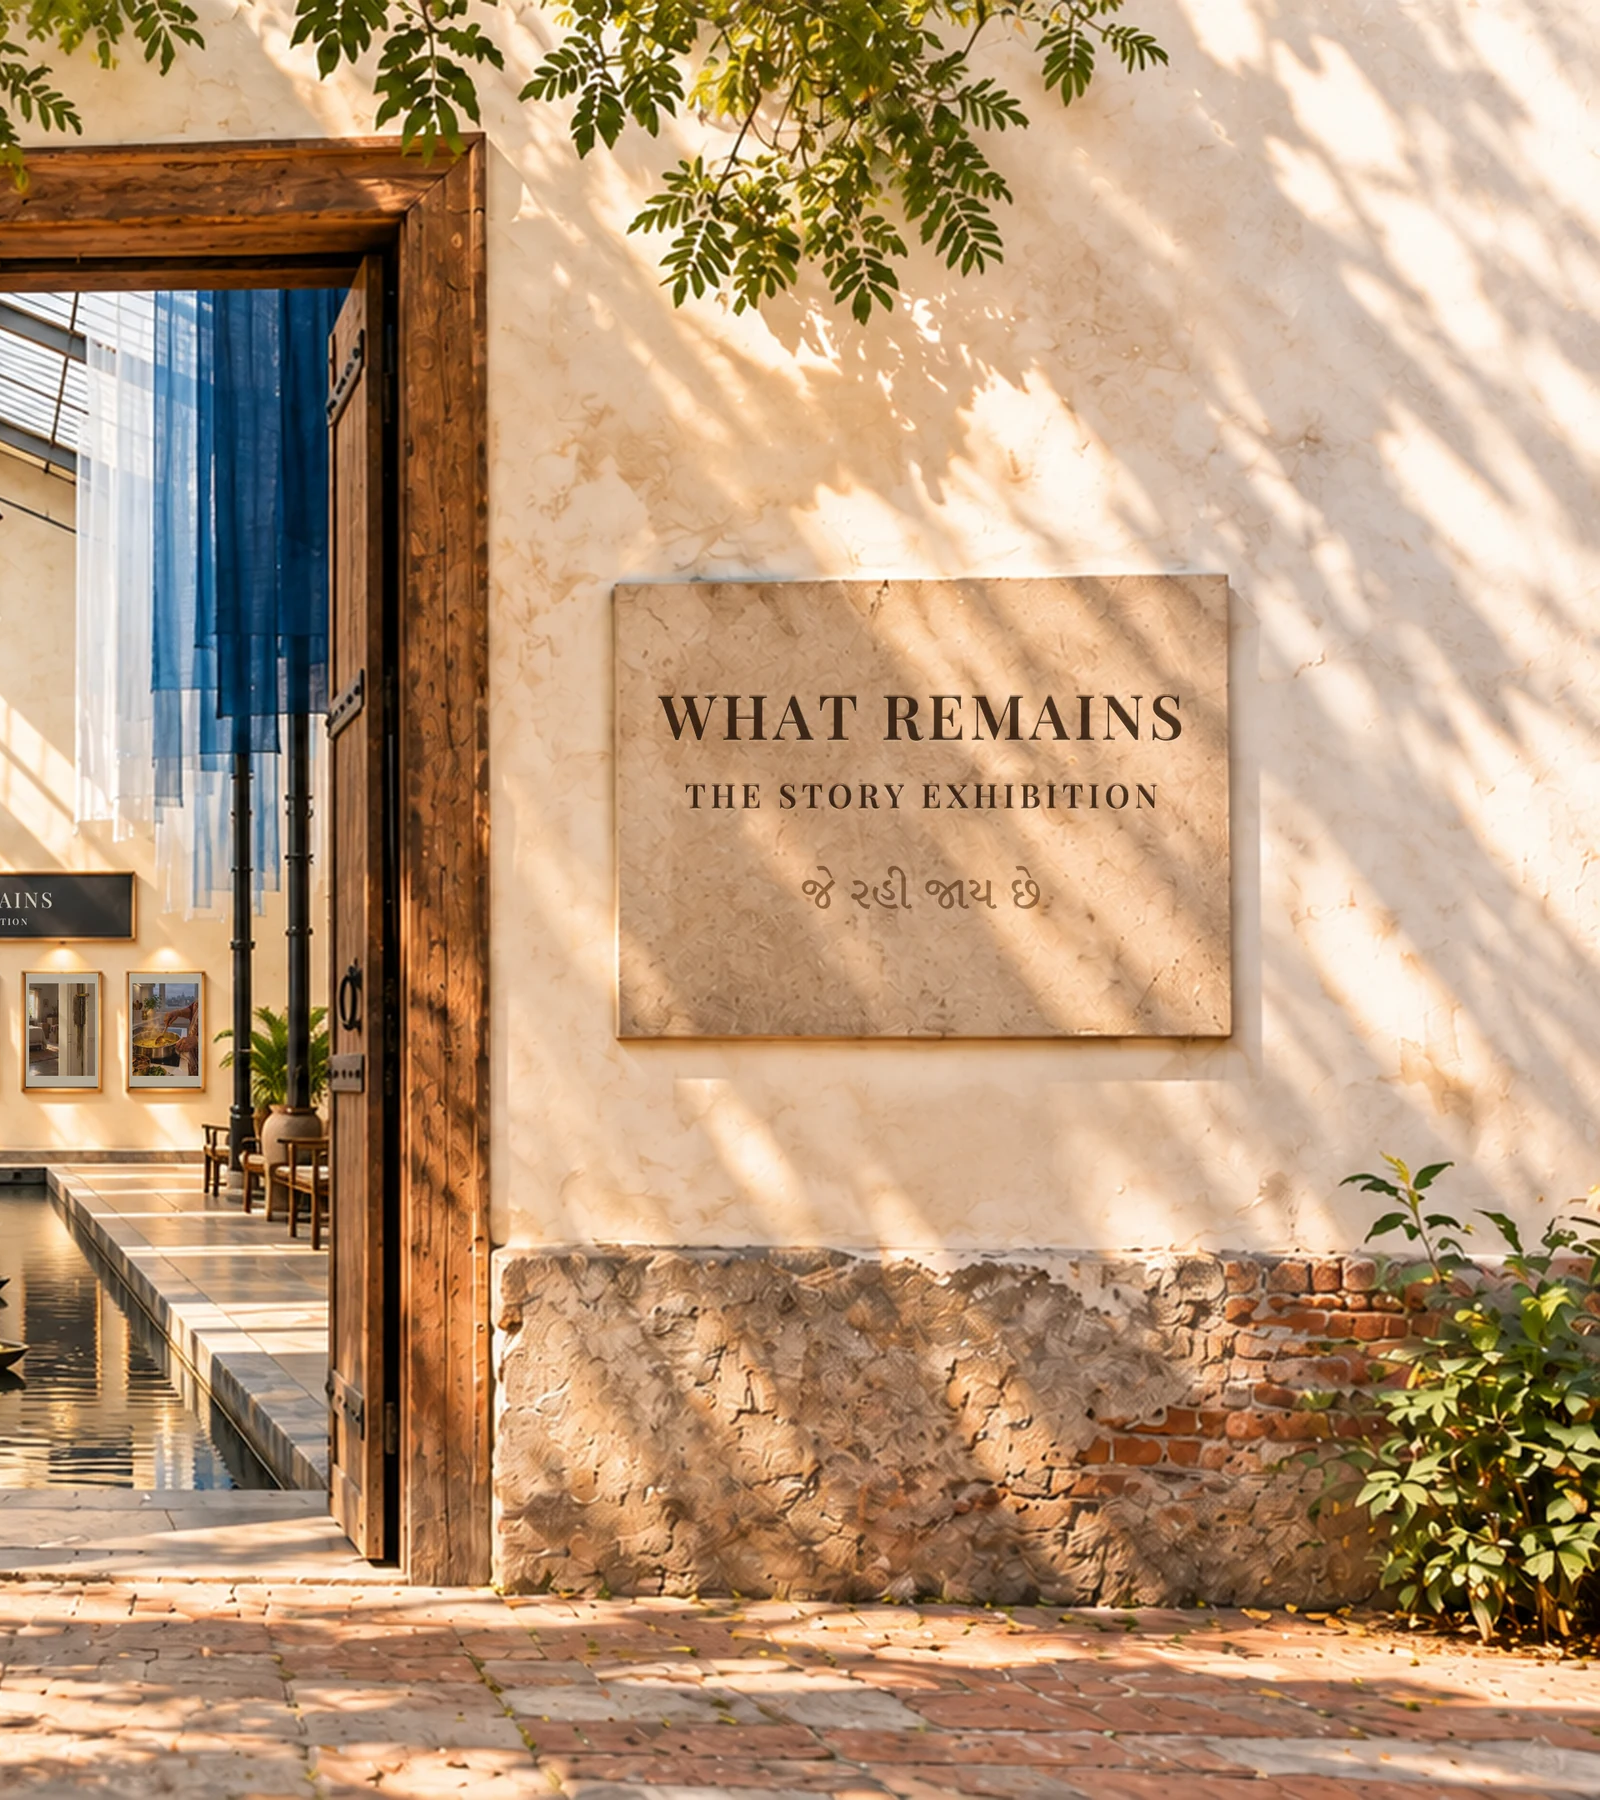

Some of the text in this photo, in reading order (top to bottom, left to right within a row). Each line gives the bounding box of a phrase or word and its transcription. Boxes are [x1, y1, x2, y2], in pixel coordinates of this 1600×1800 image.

[657, 694, 1183, 742] WHAT REMAINS
[684, 782, 1159, 810] THE STORY EXHIBITION
[801, 865, 1041, 910] જે રહી જાય છે
